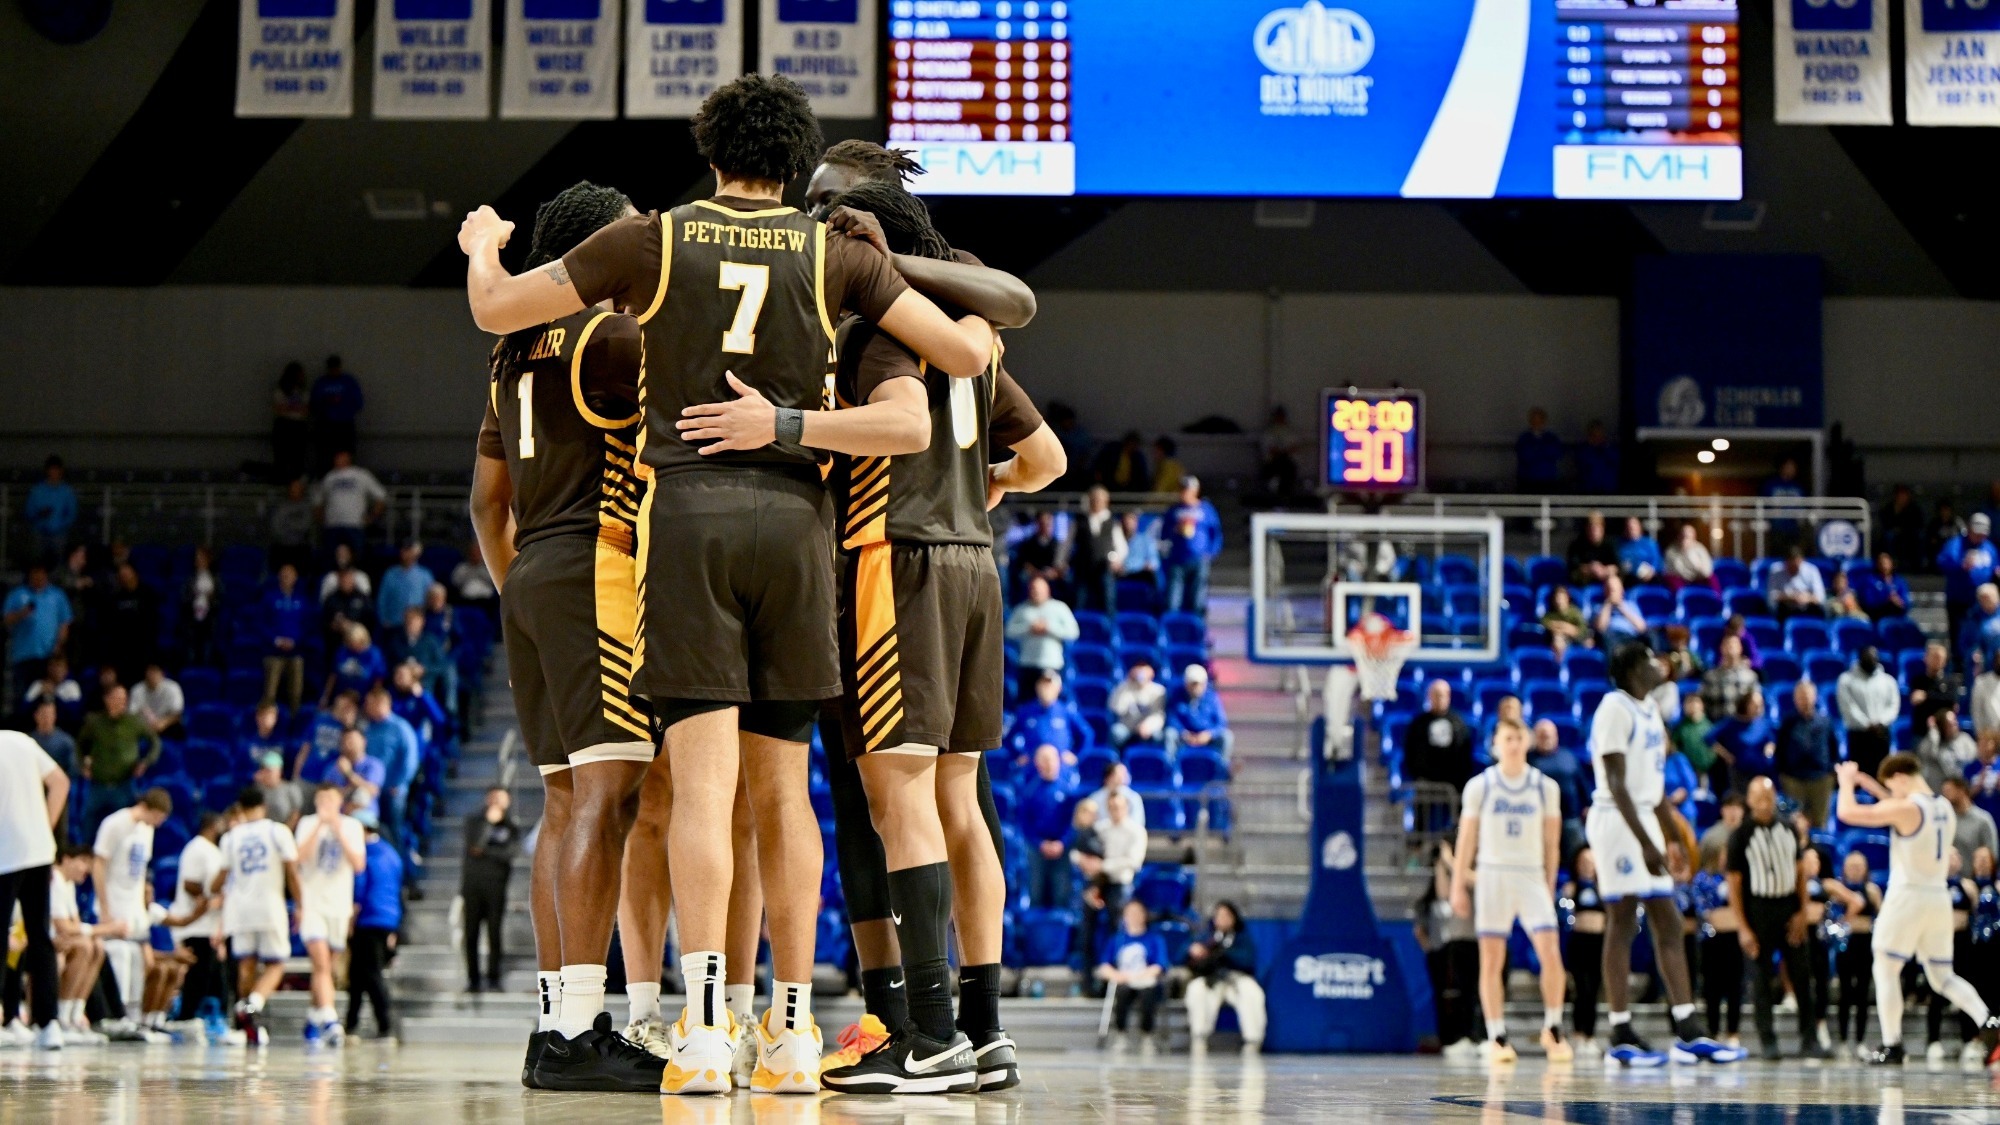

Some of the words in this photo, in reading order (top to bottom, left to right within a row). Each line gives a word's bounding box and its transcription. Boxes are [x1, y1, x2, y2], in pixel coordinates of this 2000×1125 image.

[262, 25, 330, 44] DOLPH
[399, 27, 466, 46] WILLIE
[527, 26, 594, 46] WILLIE
[652, 31, 716, 50] LEWIS
[793, 30, 841, 49] RED
[1795, 37, 1869, 57] WANDA
[1943, 39, 1985, 59] JAN
[250, 51, 341, 70] PULLIAM
[413, 53, 482, 72] CARTER
[535, 53, 584, 72] WISE
[651, 56, 718, 76] LLOYD
[1803, 64, 1860, 82] FORD
[1927, 65, 2000, 85] JENSEN
[1260, 75, 1297, 104] DES
[1298, 75, 1373, 104] MOINES
[921, 147, 1041, 175] FMH
[1588, 152, 1708, 180] FMH
[683, 221, 806, 252] PETTIGREW
[719, 261, 769, 354] 7
[518, 372, 535, 459] 1
[1332, 400, 1413, 432] 20:00
[1343, 430, 1404, 482] 30
[1294, 955, 1385, 984] Smart
